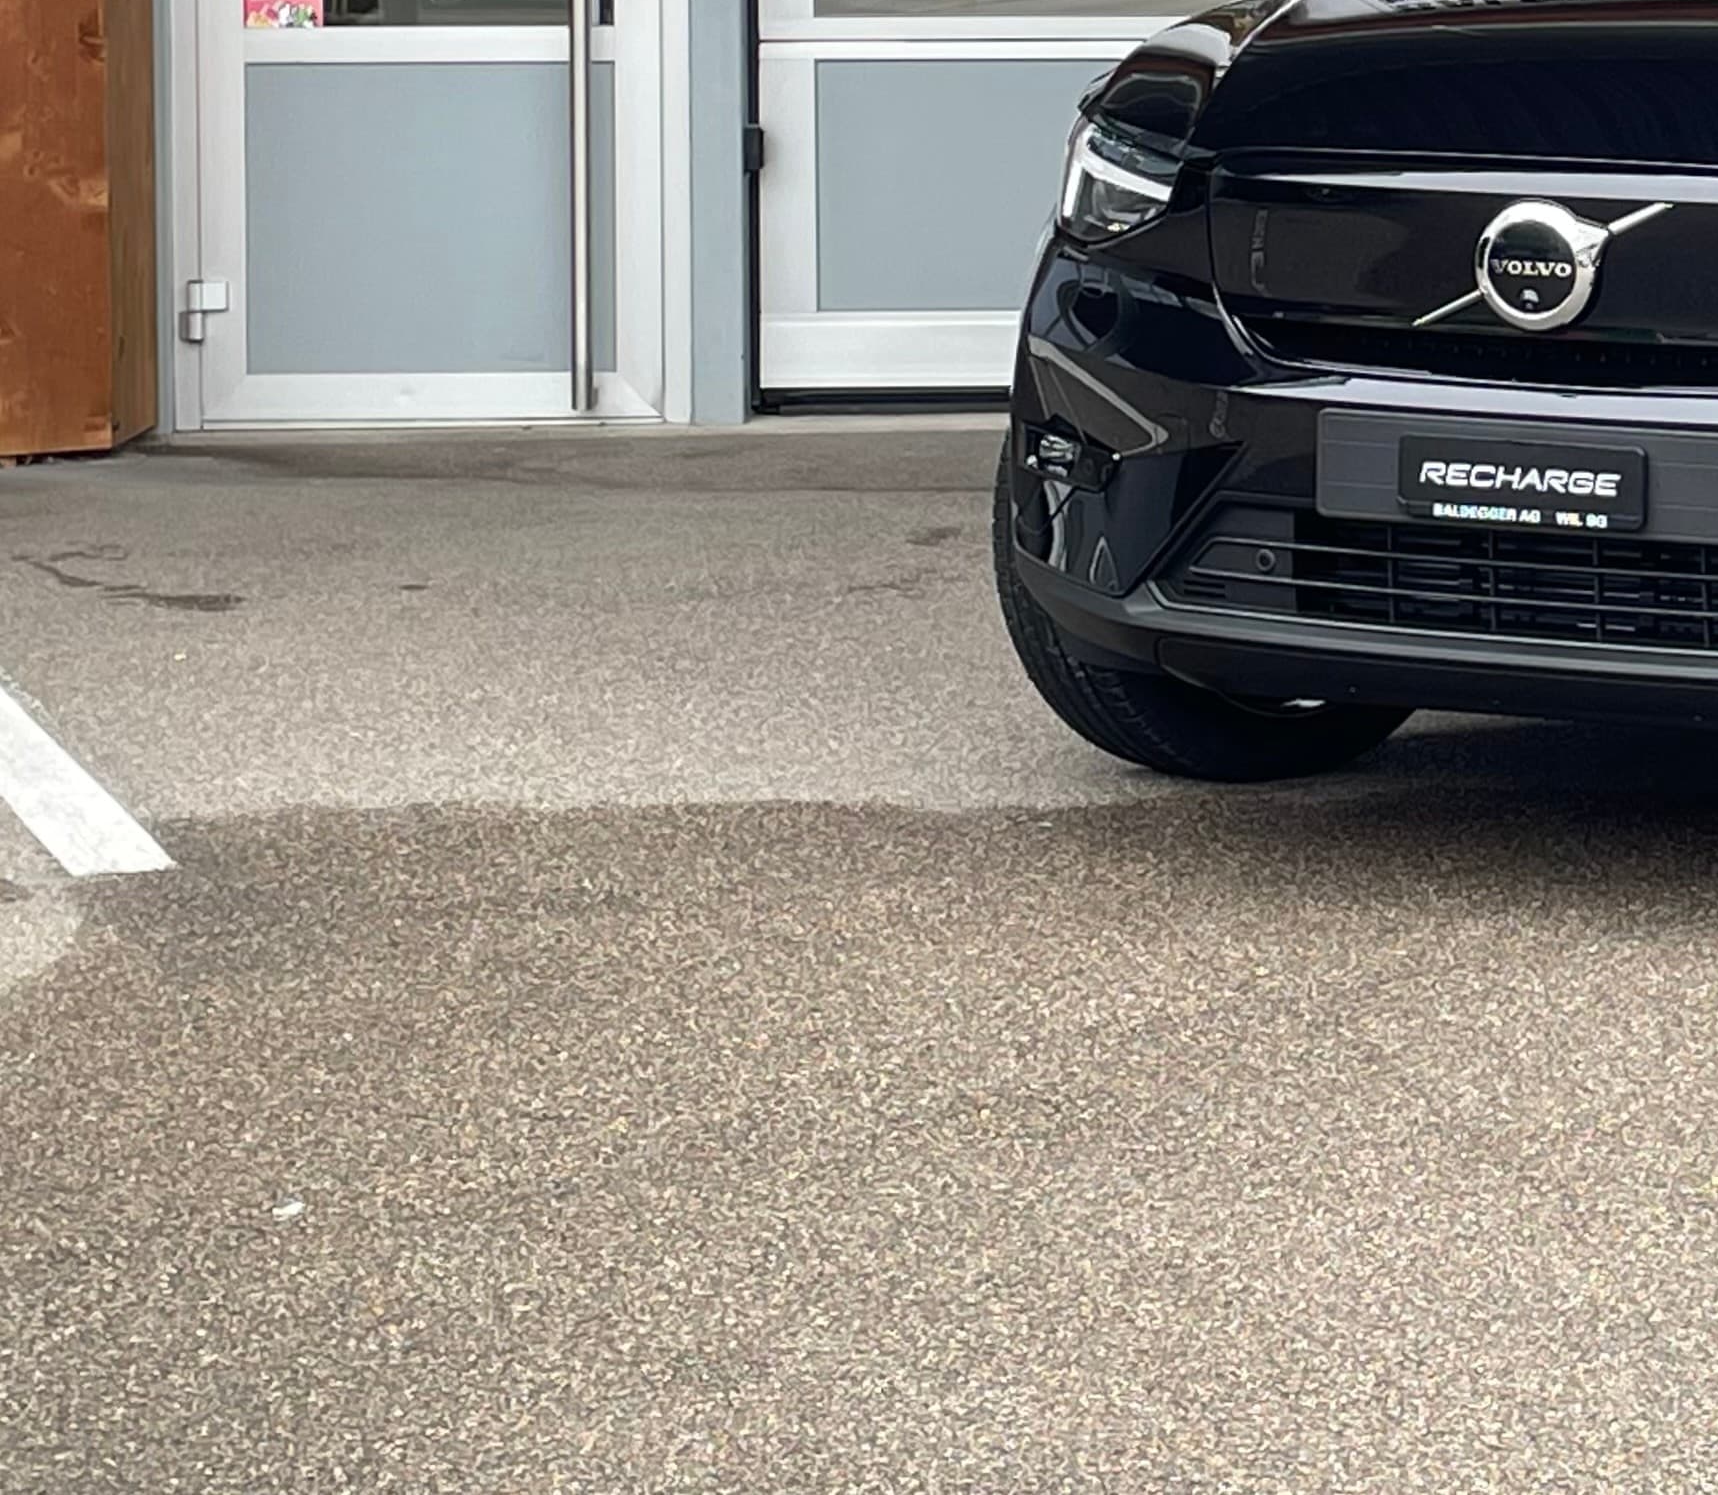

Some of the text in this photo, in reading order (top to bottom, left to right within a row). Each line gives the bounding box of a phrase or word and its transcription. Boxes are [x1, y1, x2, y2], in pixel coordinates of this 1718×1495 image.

[1490, 258, 1573, 278] VOLVO
[1419, 461, 1621, 497] RECHARGE
[1432, 502, 1517, 522] BALDEGGER
